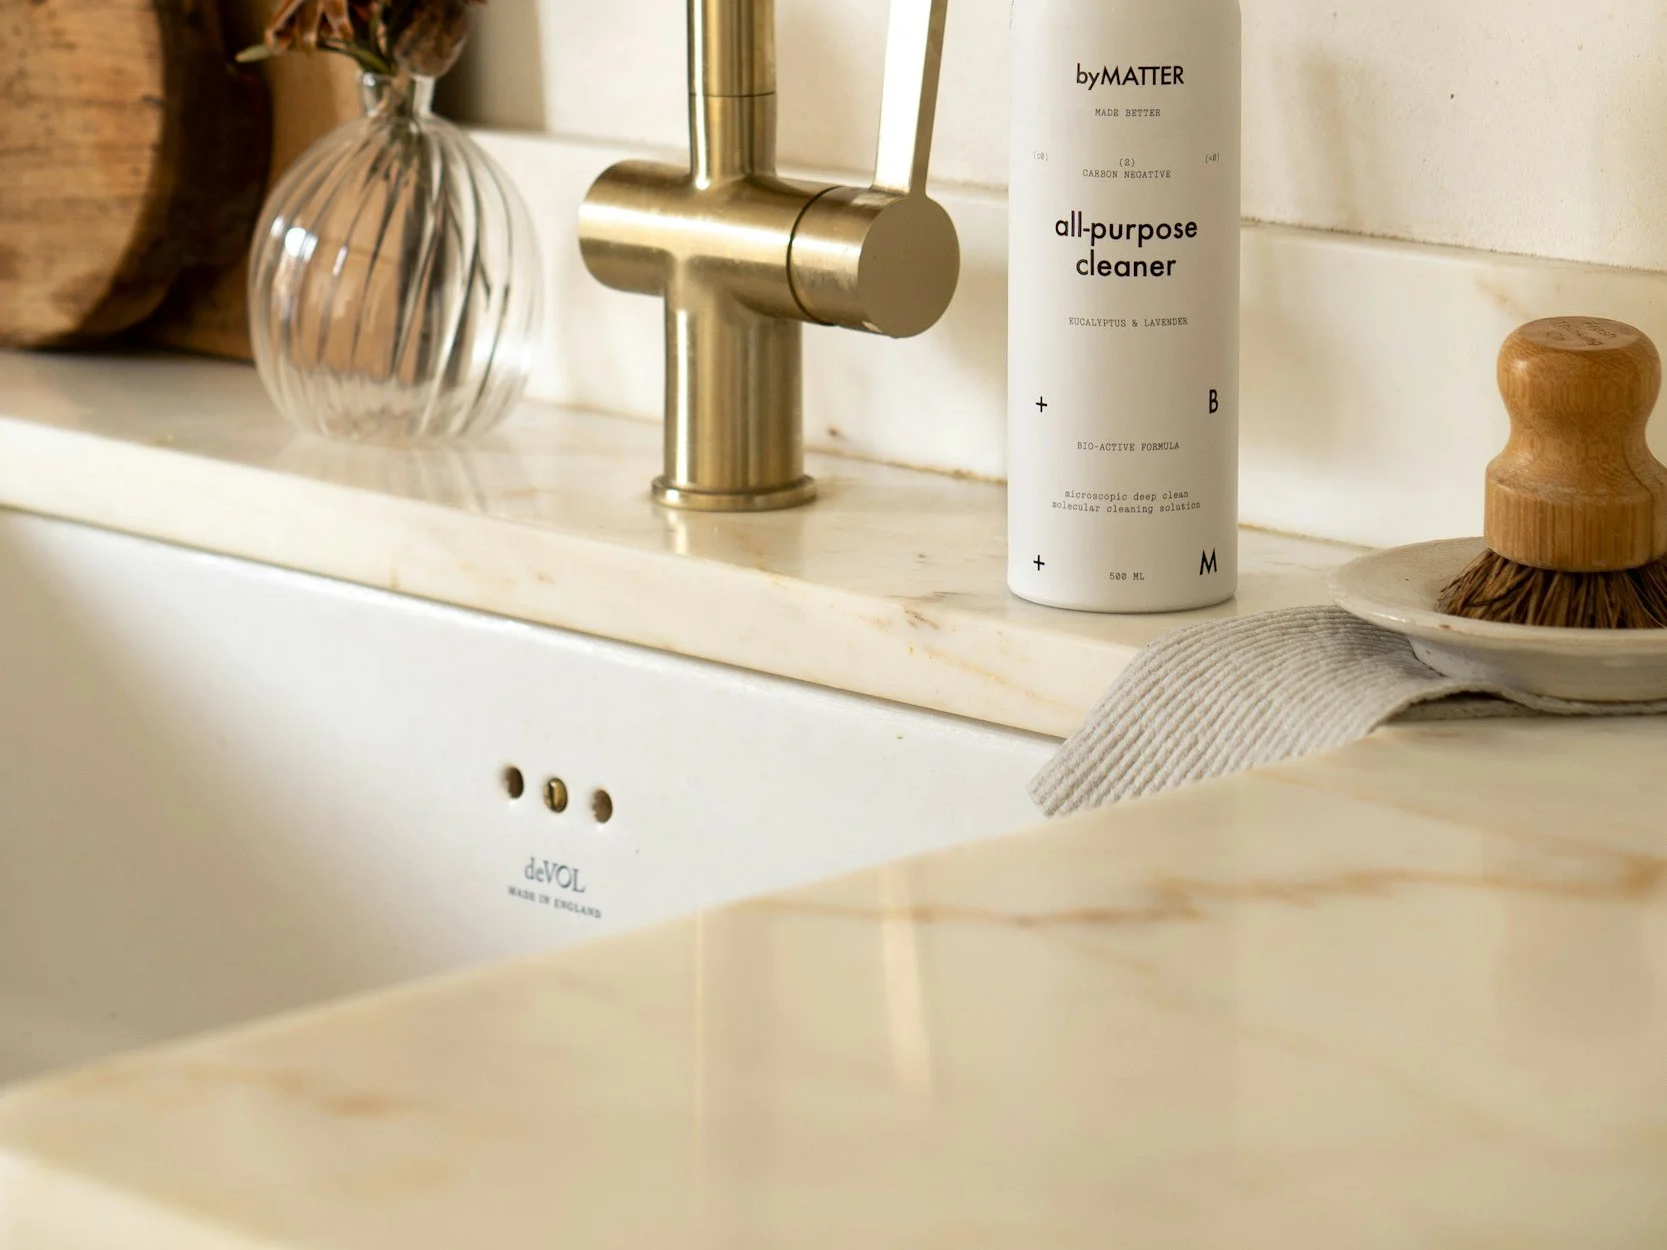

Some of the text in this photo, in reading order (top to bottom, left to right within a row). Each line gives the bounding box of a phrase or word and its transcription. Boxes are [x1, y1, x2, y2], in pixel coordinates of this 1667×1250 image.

[1076, 63, 1184, 90] byMATTER
[1095, 108, 1161, 117] MADE BETTER
[1083, 169, 1171, 179] CARBON NEGATIVE
[1055, 211, 1198, 247] all-purpose
[1076, 249, 1176, 277] cleaner
[1069, 317, 1188, 327] EUCALYPTUS & LAVENDER
[1209, 389, 1218, 413] B
[1077, 442, 1180, 451] BIO-ACTIVE FORMULA
[1065, 489, 1188, 502] microscopic deep clean
[1052, 501, 1201, 514] molecular cleaning solution
[1199, 548, 1217, 575] M
[1133, 572, 1144, 581] ML
[524, 856, 585, 893] deVOL
[508, 886, 601, 918] MADE IN ENGLAND
